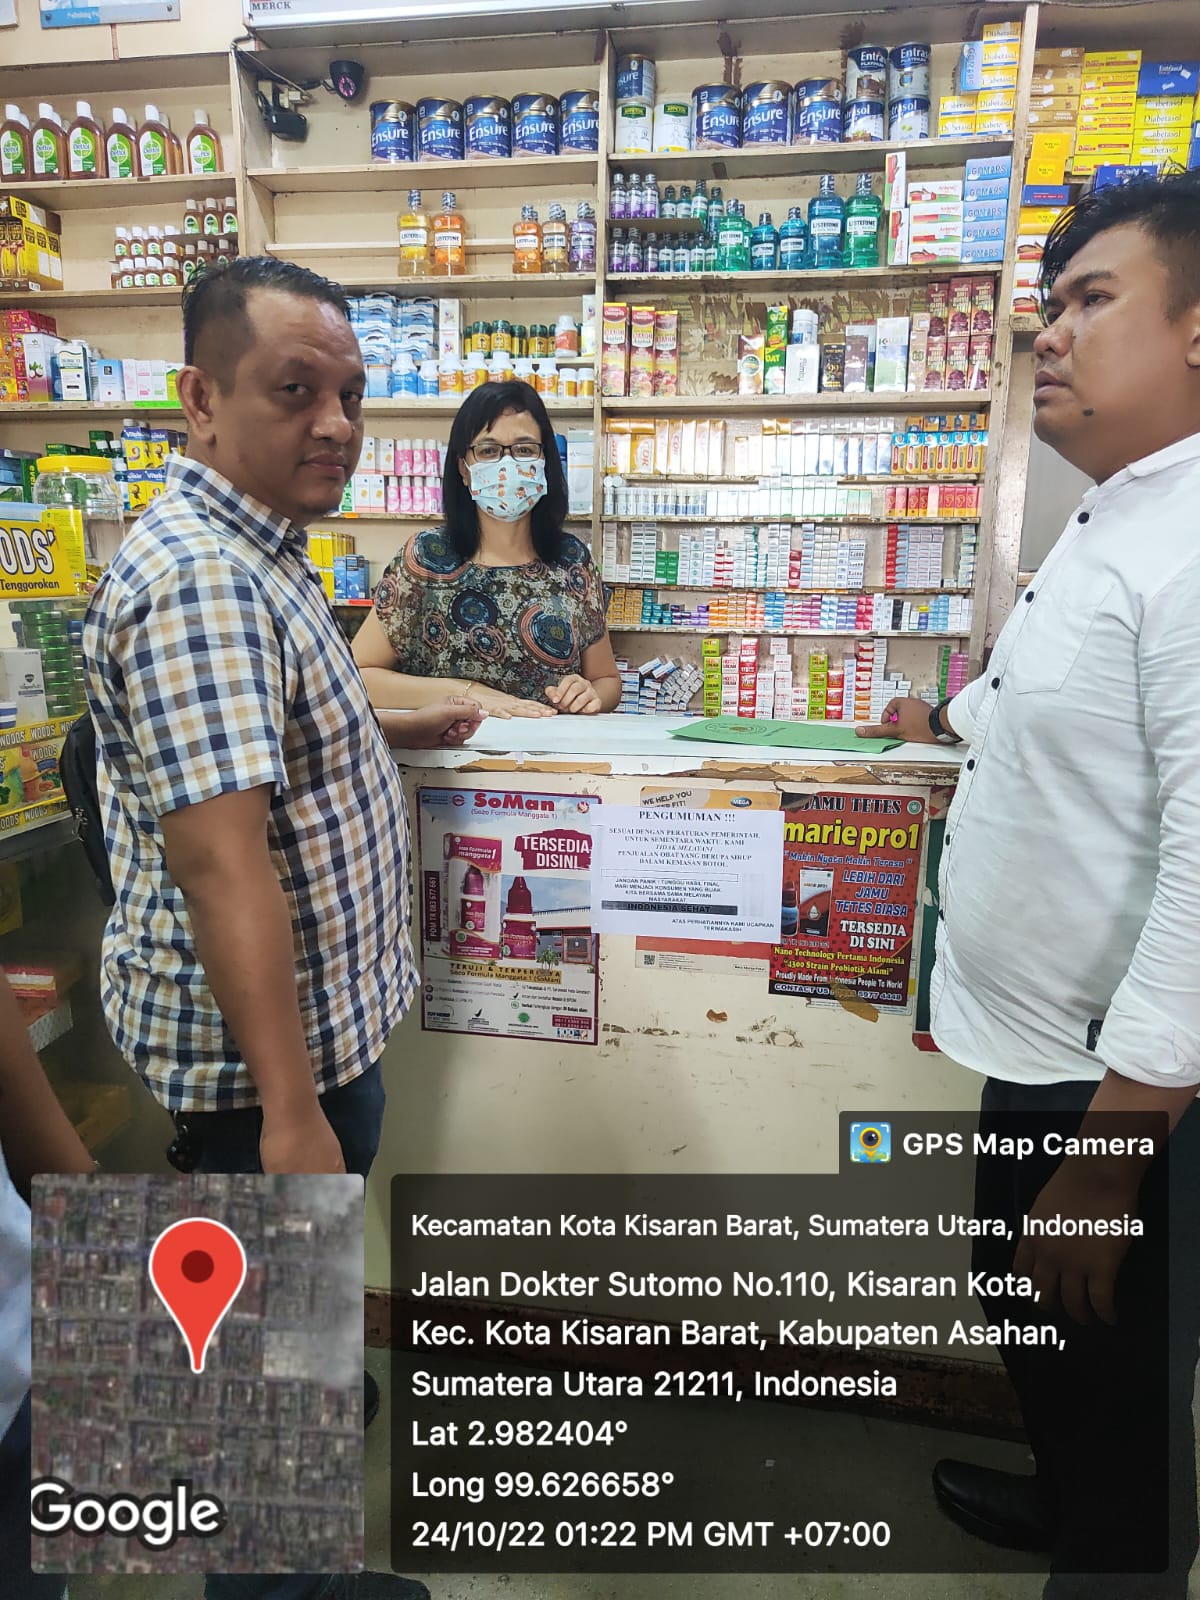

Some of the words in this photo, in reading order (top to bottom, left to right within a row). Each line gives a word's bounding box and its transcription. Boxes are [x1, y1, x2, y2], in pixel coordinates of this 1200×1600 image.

[252, 1, 291, 10] MERCK
[702, 111, 740, 130] Ensure
[743, 108, 783, 127] Ensure
[800, 105, 841, 126] Ensure
[421, 126, 461, 145] Ensure
[469, 124, 508, 143] Ensure
[562, 119, 599, 138] Ensure
[371, 128, 409, 148] Ensure
[0, 578, 60, 593] Tenggorokan
[474, 792, 555, 812] SoMan
[656, 794, 675, 803] HELP
[676, 790, 692, 799] YOU
[672, 800, 686, 809] FIT!
[802, 795, 845, 812] JAMU
[851, 797, 901, 814] TETES
[490, 809, 517, 817] Formula
[518, 811, 550, 820] Manggata
[639, 810, 721, 822] PENGUMUMAN
[724, 813, 736, 822] !!!
[666, 829, 709, 837] PERATURAN
[784, 818, 858, 847] marie
[521, 836, 590, 854] TERSEDIA
[536, 853, 579, 869] DISINI
[790, 851, 815, 862] Makin
[817, 853, 843, 865] Nyata
[845, 855, 871, 866] Makin
[873, 857, 905, 868] Terasa
[842, 870, 876, 884] LEBIH
[878, 872, 905, 886] DARI
[855, 887, 889, 900] JAMU
[627, 902, 681, 912] INDONESIA
[681, 904, 711, 913] SEHAT
[835, 900, 873, 915] TETES
[874, 903, 908, 917] BIASA
[840, 920, 907, 937] TERSEDIA
[850, 935, 865, 948] DI
[866, 937, 896, 951] SINI
[774, 946, 793, 956] Nano
[794, 947, 835, 960] Technology
[837, 951, 868, 962] Pertama
[869, 954, 905, 965] Indonesia
[450, 962, 483, 971] TERUJI
[467, 970, 494, 978] Formula
[806, 960, 829, 970] Strain
[830, 962, 866, 974] Probiotik
[775, 969, 796, 982] Proudly
[797, 972, 813, 981] Made
[813, 973, 828, 982] From
[857, 977, 877, 989] People
[878, 979, 886, 988] To
[886, 980, 903, 989] World
[774, 983, 815, 994] CONTACT
[816, 986, 830, 995] US
